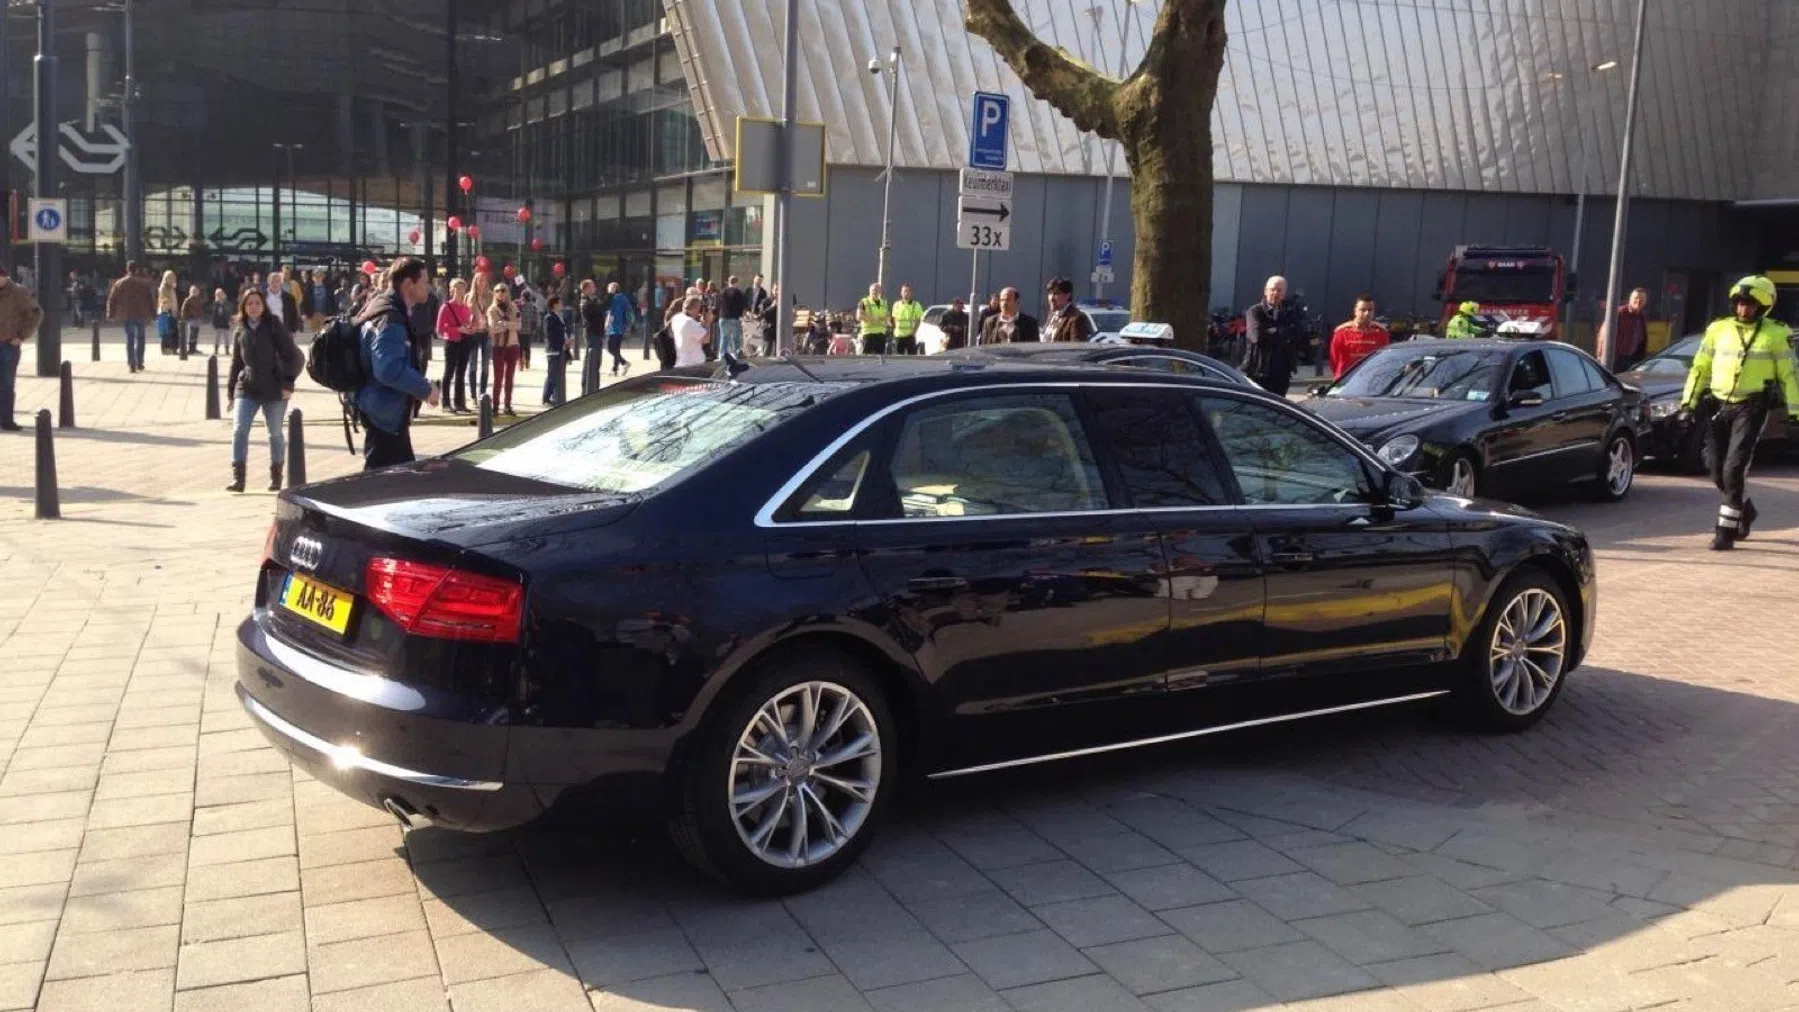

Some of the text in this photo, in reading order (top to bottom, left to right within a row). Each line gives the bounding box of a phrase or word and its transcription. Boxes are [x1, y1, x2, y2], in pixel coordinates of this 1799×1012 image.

[982, 100, 1002, 137] P
[970, 225, 1002, 247] 33x
[1101, 242, 1110, 255] P
[296, 581, 337, 621] AA-86
